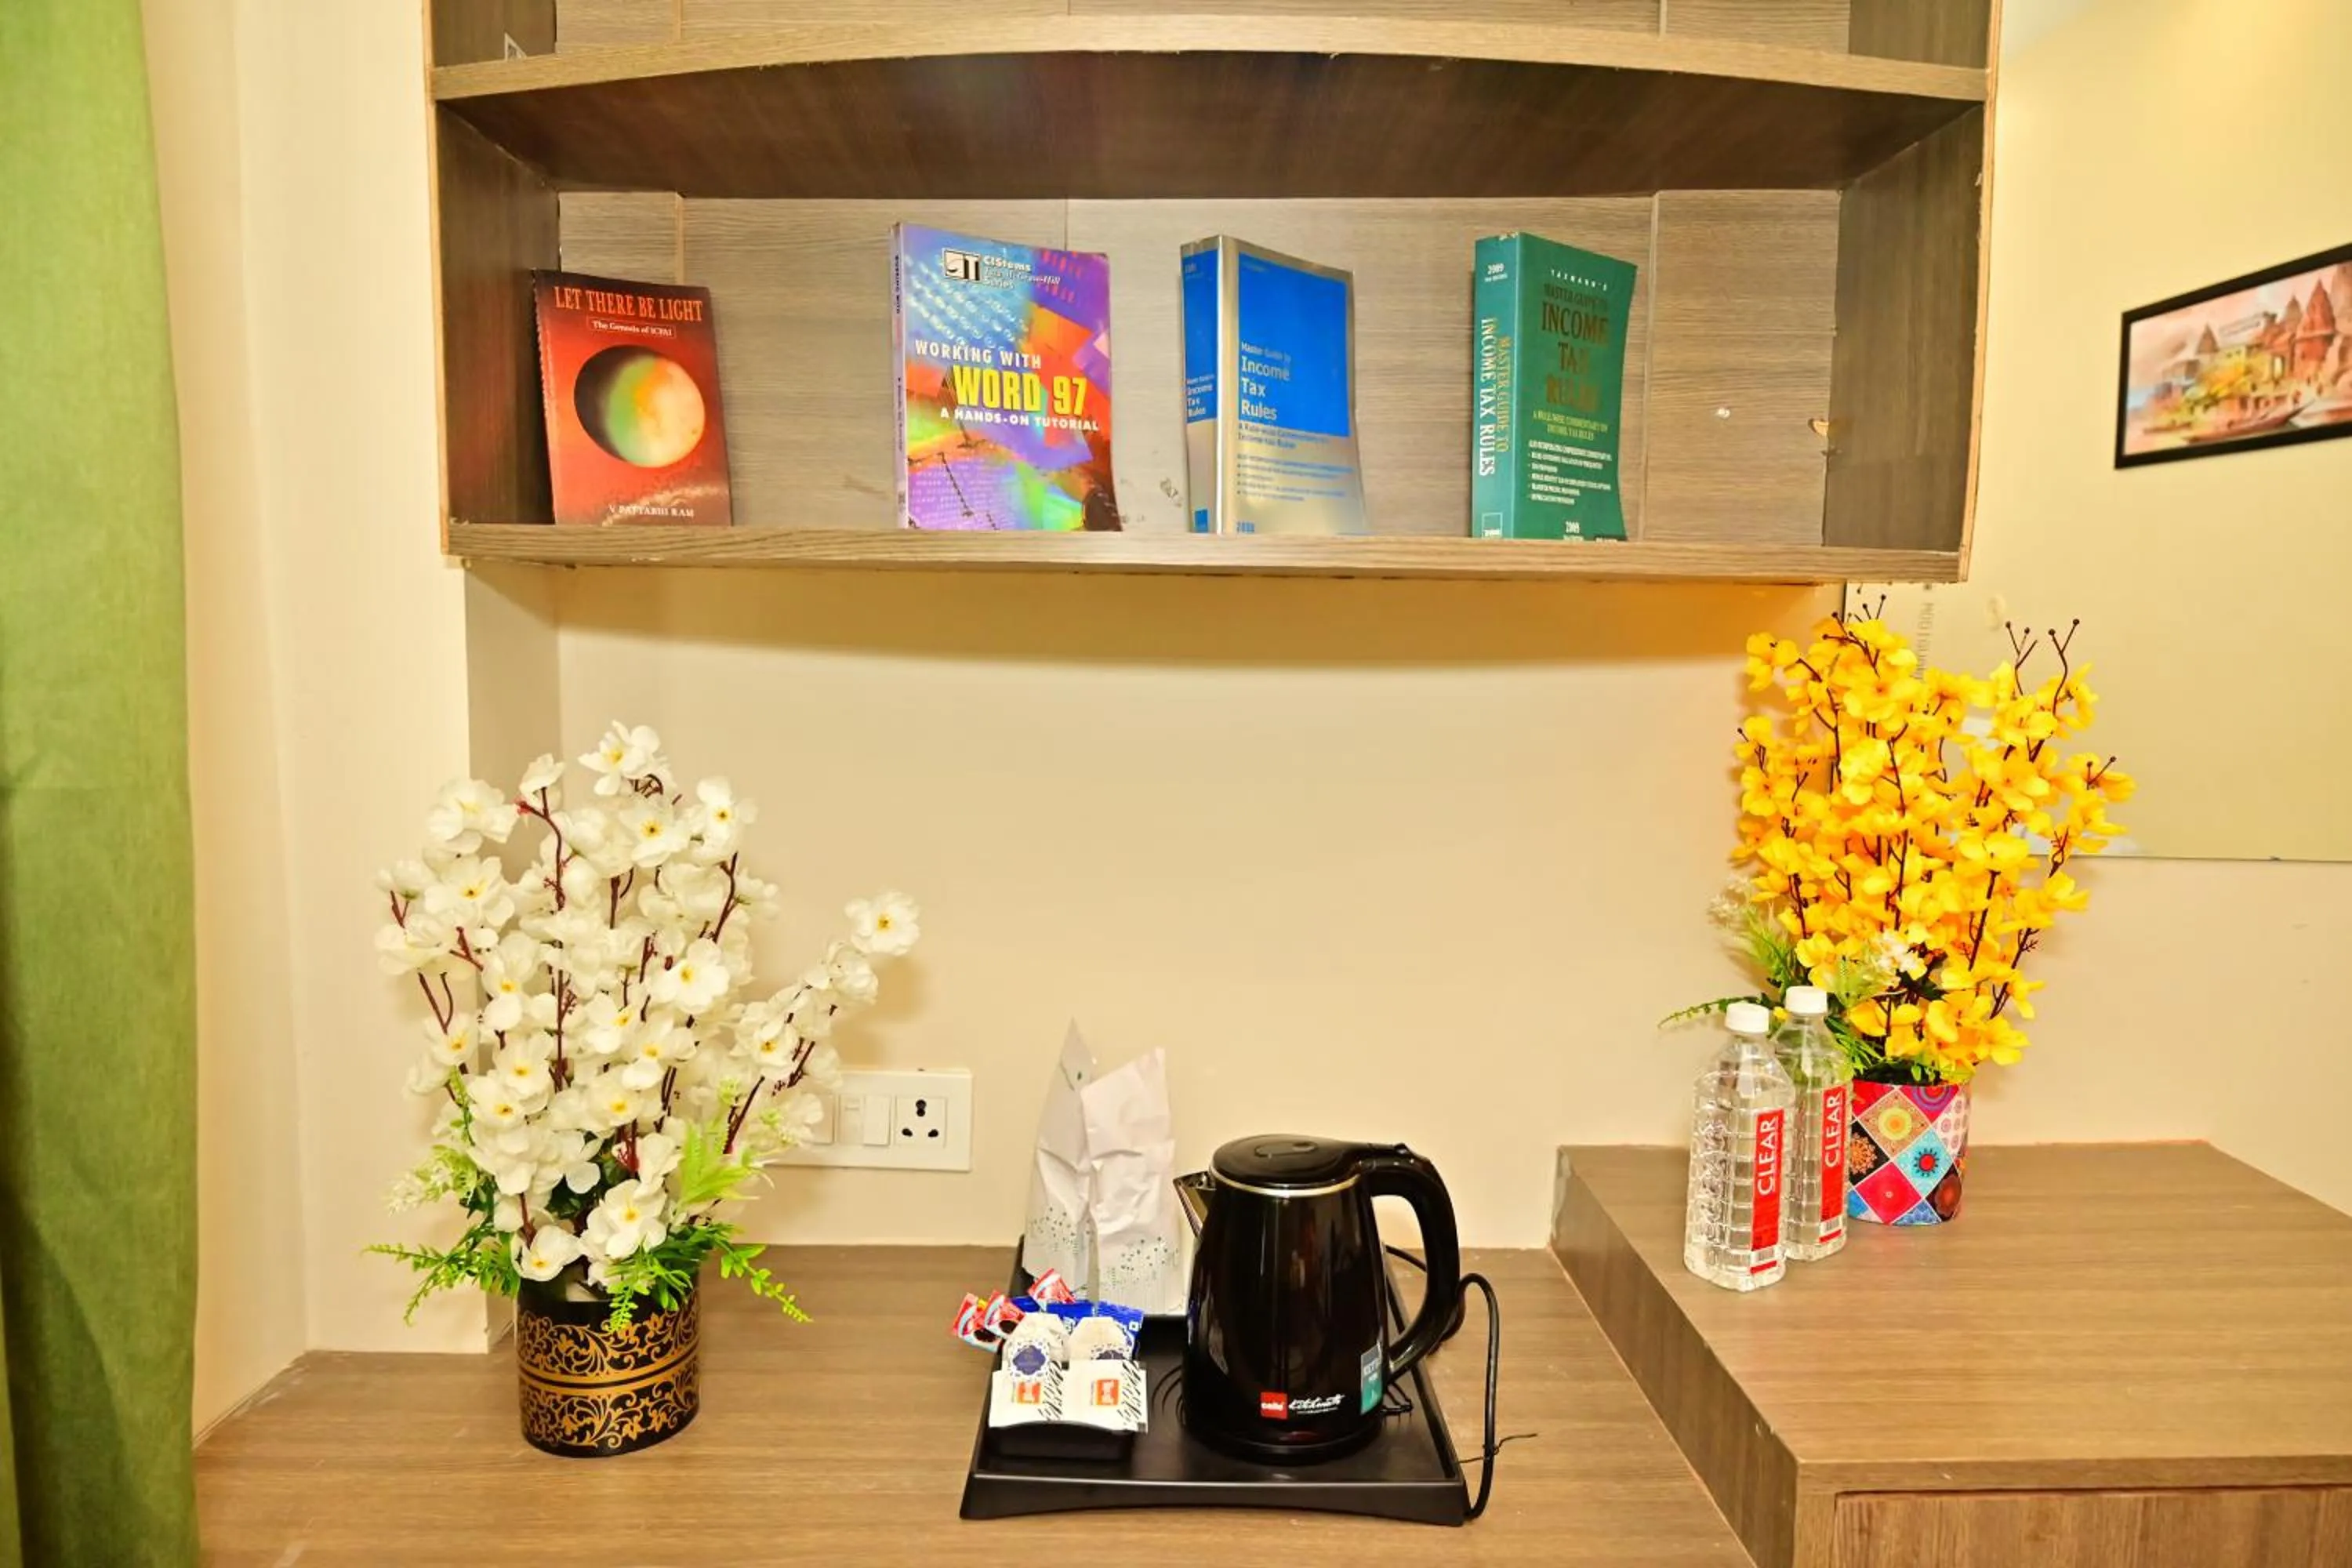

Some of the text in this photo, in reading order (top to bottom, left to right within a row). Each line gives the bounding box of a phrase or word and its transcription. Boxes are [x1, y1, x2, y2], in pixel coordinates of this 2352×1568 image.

[554, 286, 703, 322] LET THERE BE LIGHT
[593, 321, 608, 330] The
[641, 325, 649, 334] of
[1542, 300, 1609, 345] INCOME
[915, 339, 1041, 369] WORKING WITH
[1241, 355, 1290, 381] Income
[953, 364, 1087, 416] WORD 97
[1241, 377, 1266, 398] Tax
[1479, 318, 1497, 477] INCOME TAX RULES
[940, 408, 949, 419] A
[1035, 416, 1100, 431] TUTORIAL
[1241, 399, 1278, 420] Rules
[1825, 1091, 1841, 1167] CLEAR
[1757, 1116, 1777, 1196] CLEAR
